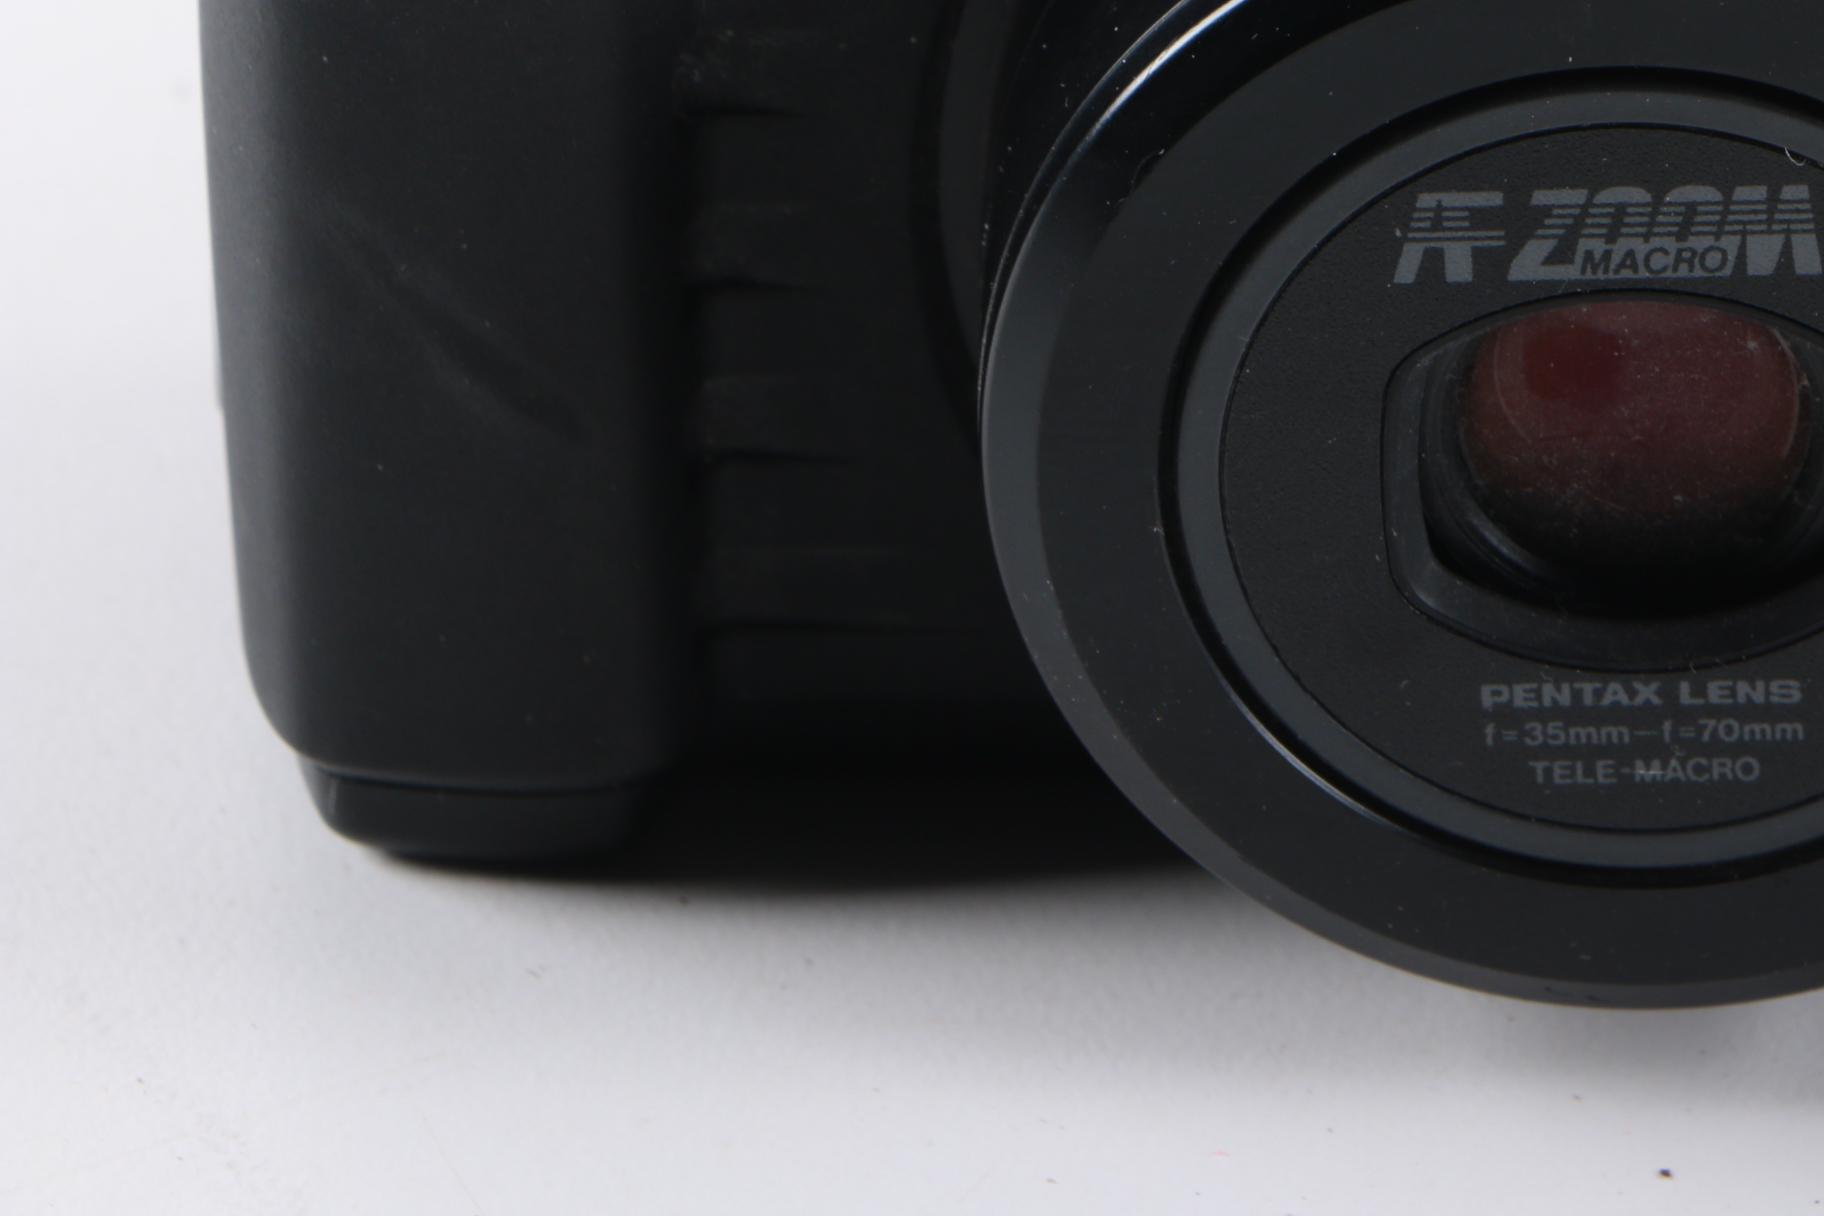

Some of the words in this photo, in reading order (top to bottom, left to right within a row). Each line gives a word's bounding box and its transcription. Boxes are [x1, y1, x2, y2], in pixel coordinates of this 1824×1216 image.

[1507, 184, 1823, 282] ZOOM
[1579, 245, 1729, 277] MACRO
[1481, 681, 1663, 708] PENTAX
[1678, 680, 1802, 705] LENS
